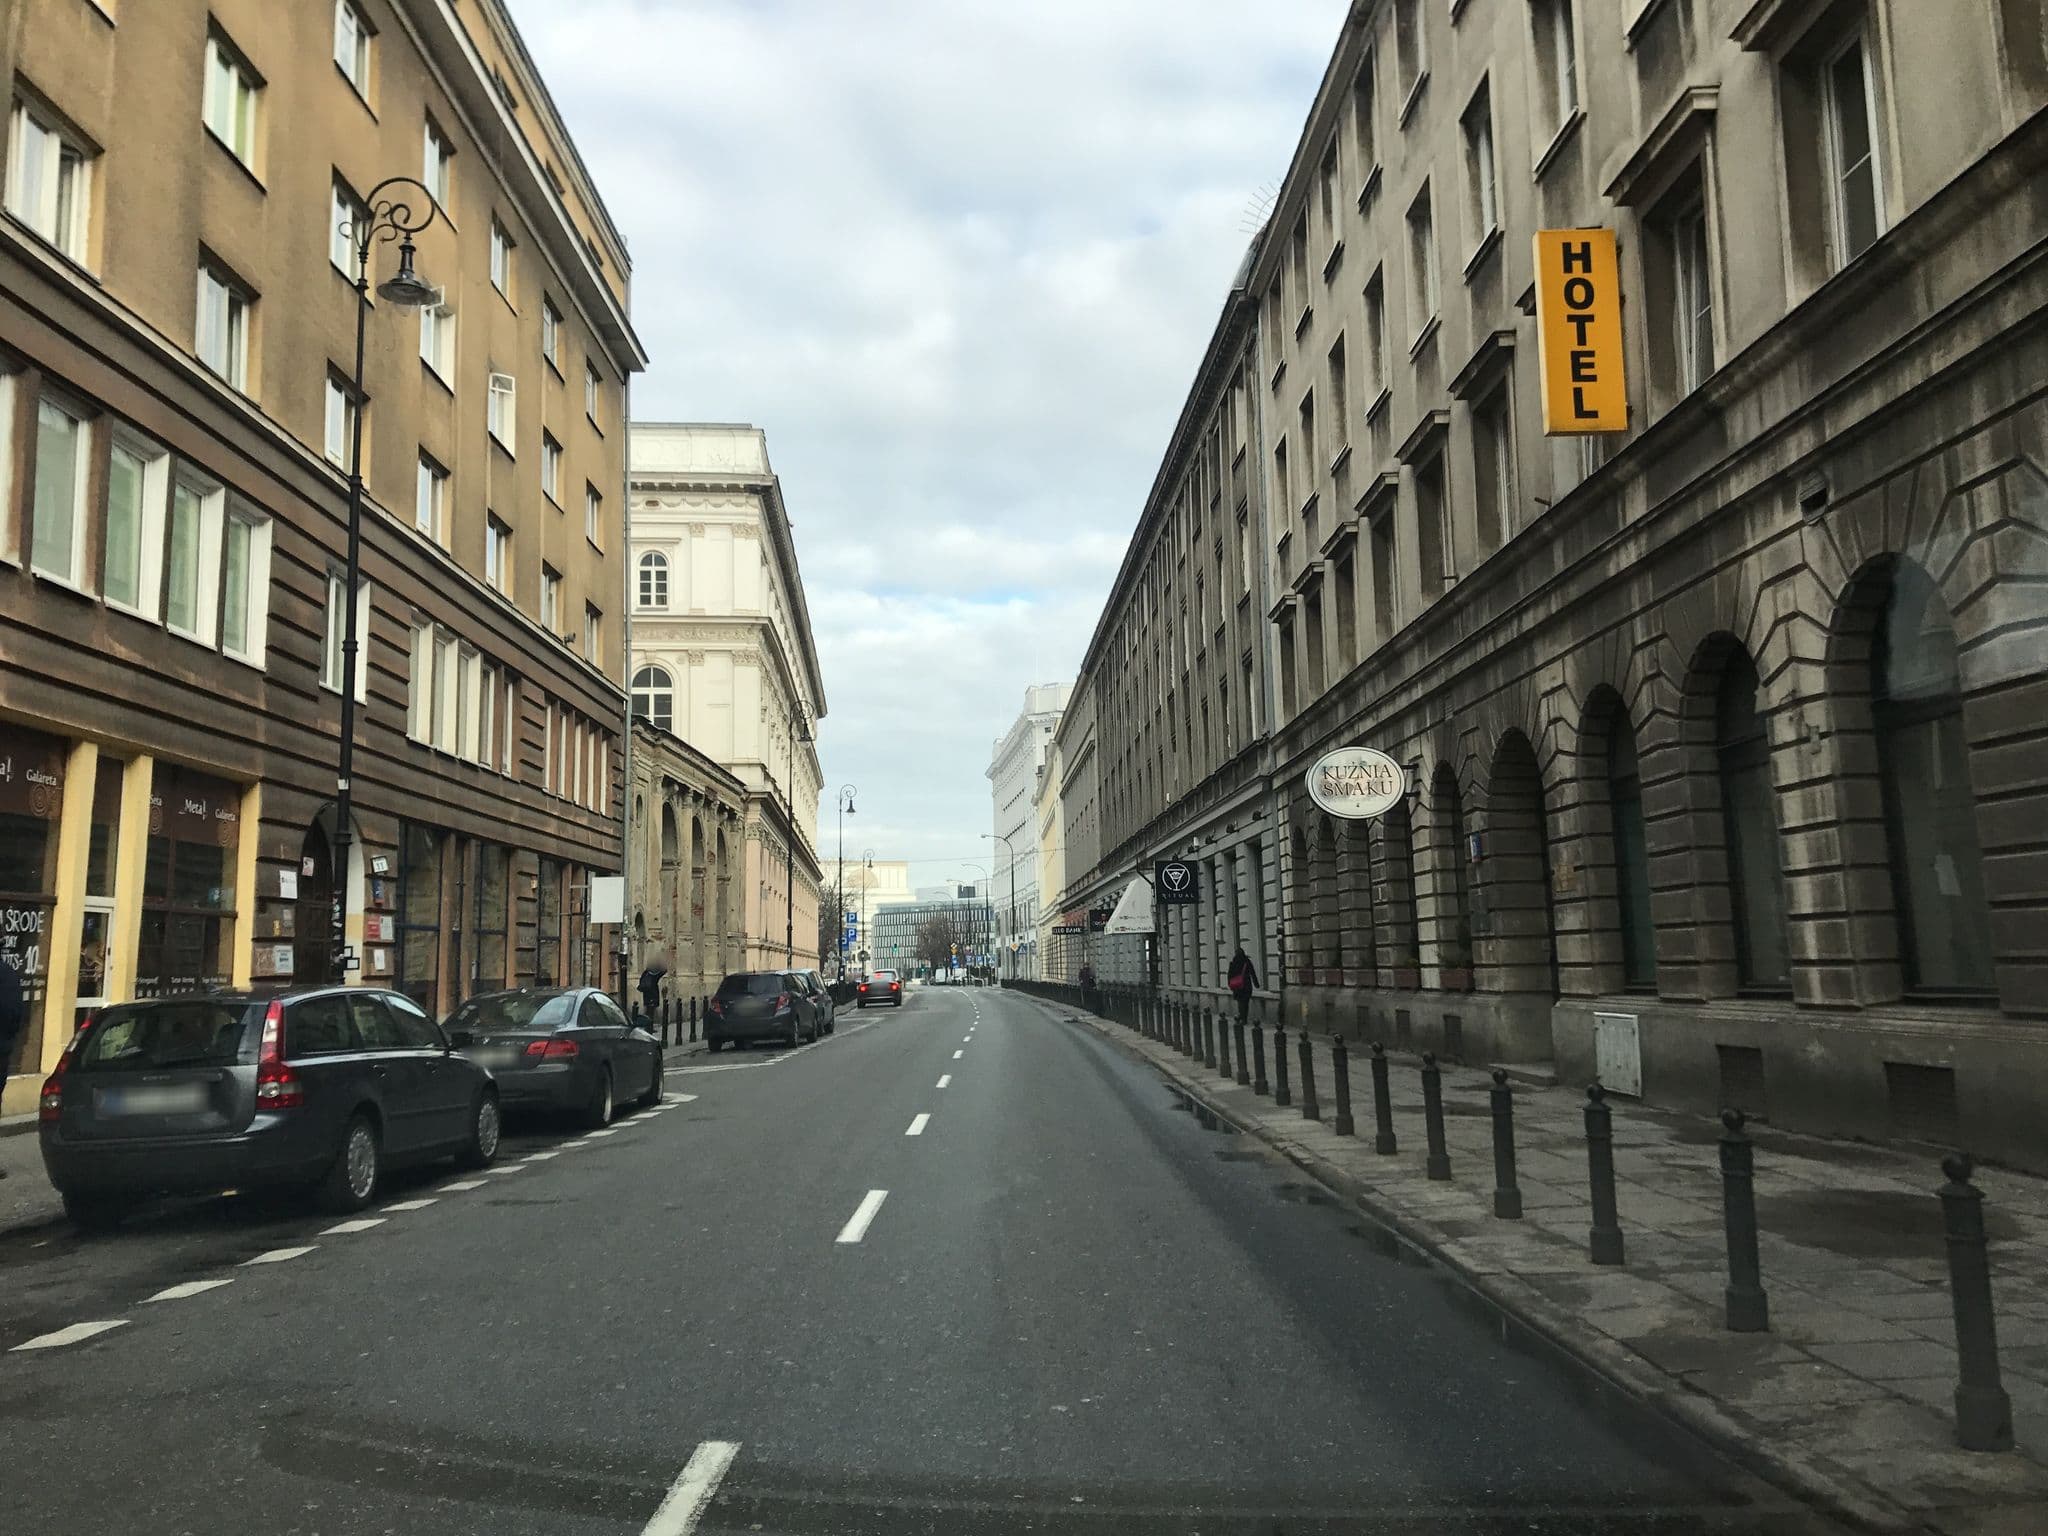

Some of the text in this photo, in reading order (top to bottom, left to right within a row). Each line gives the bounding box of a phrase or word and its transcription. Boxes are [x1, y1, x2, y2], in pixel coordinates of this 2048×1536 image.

[1562, 241, 1599, 419] HOTEL
[26, 768, 57, 786] Galareta
[1322, 780, 1393, 798] SMAKU
[1161, 892, 1195, 900] RITUAL
[25, 945, 39, 975] 10
